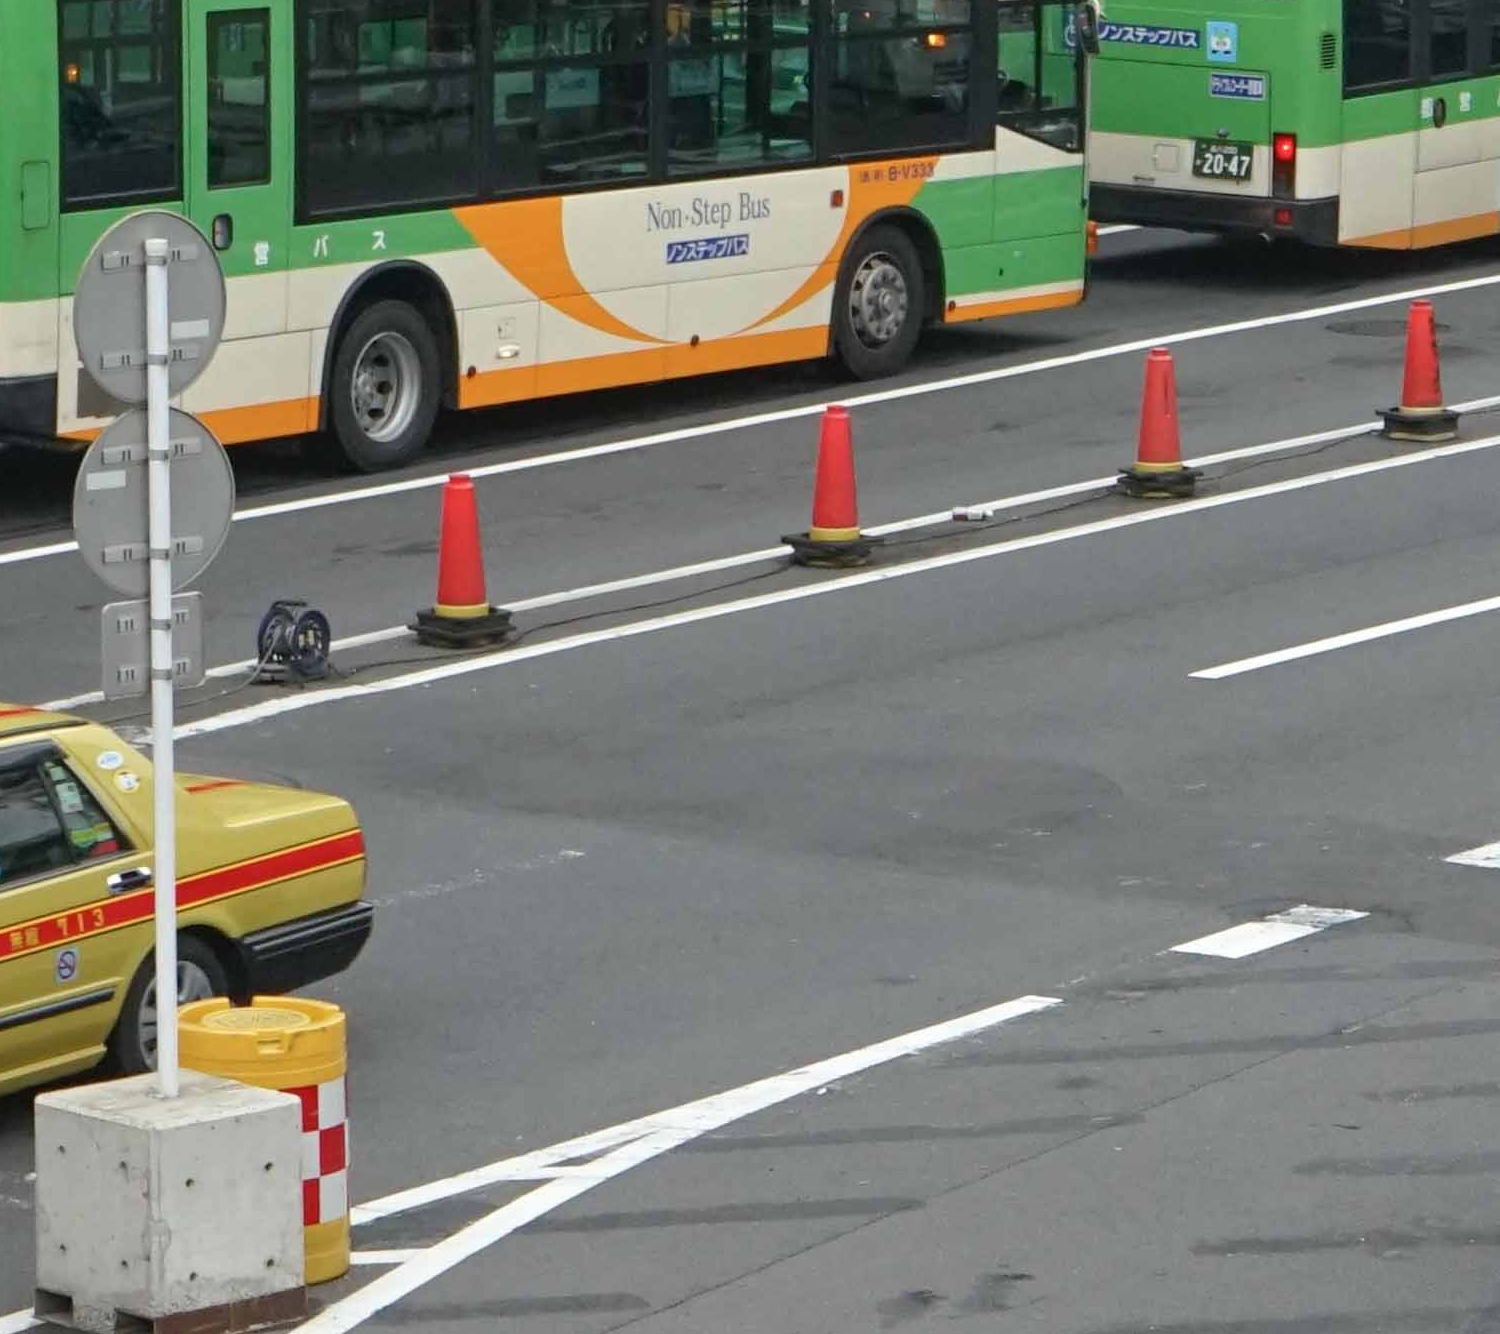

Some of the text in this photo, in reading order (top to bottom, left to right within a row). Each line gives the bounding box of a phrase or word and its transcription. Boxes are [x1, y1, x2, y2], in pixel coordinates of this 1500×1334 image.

[1100, 24, 1198, 48] ノンステップバス
[1202, 152, 1250, 177] 20-47
[738, 190, 771, 222] Bus
[669, 236, 749, 262] ノンステップバス
[56, 908, 106, 940] 713
